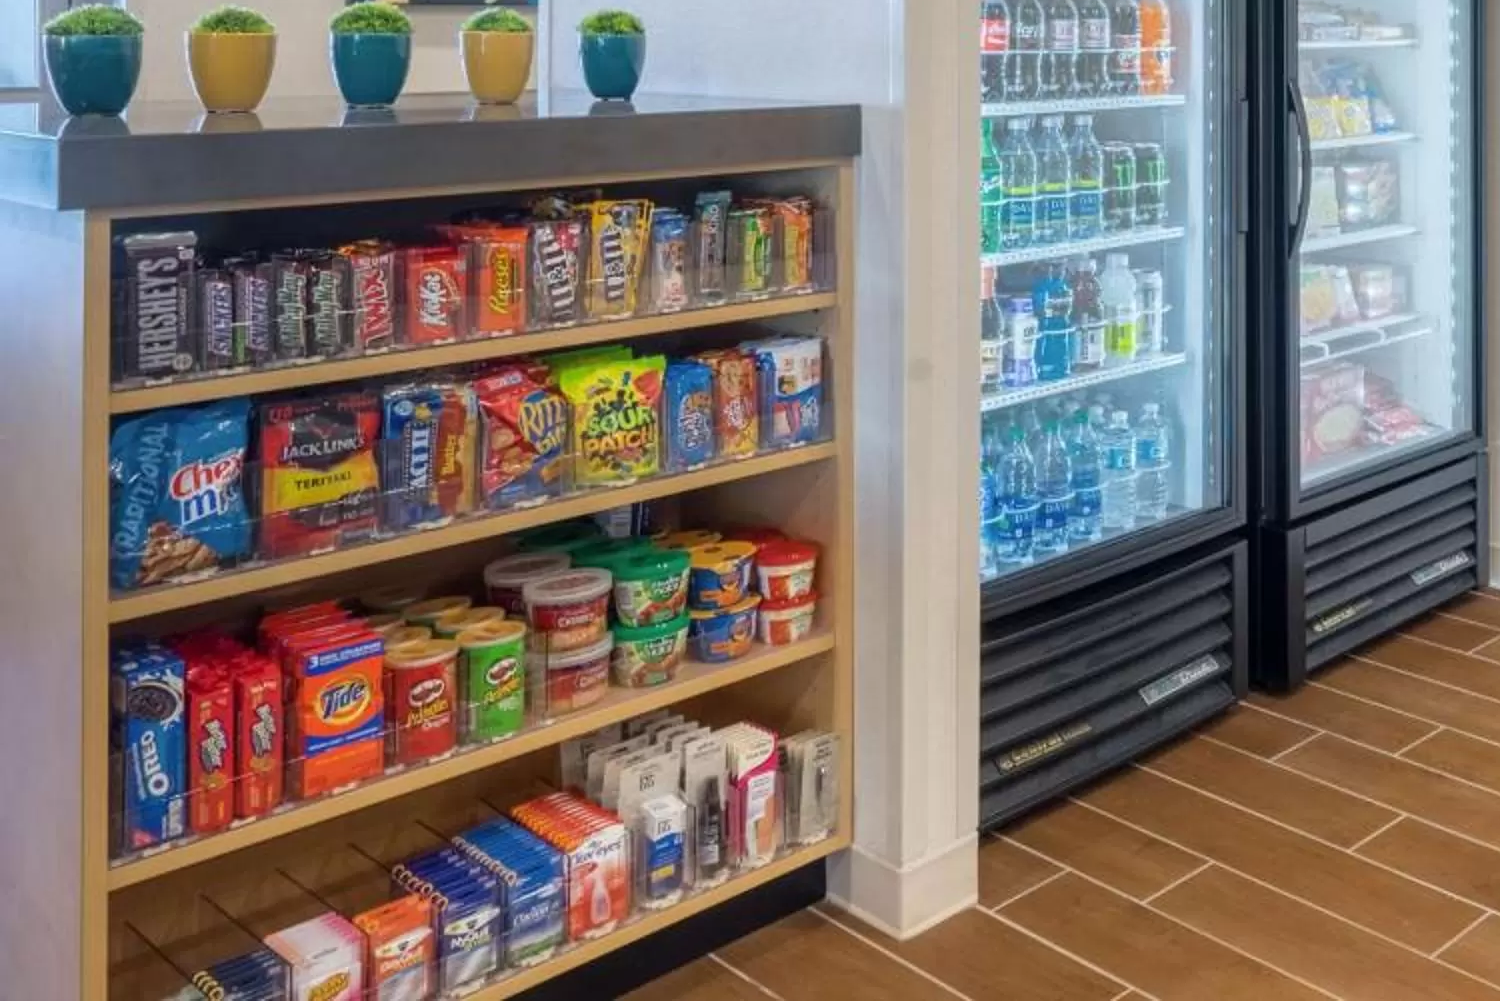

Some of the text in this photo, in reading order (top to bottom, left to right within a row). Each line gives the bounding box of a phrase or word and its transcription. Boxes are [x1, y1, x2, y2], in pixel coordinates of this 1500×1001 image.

[587, 405, 656, 437] SOUR
[283, 444, 322, 461] JACK
[294, 470, 352, 491] TERIYAKI
[320, 678, 367, 721] Tide
[140, 730, 169, 796] OREO
